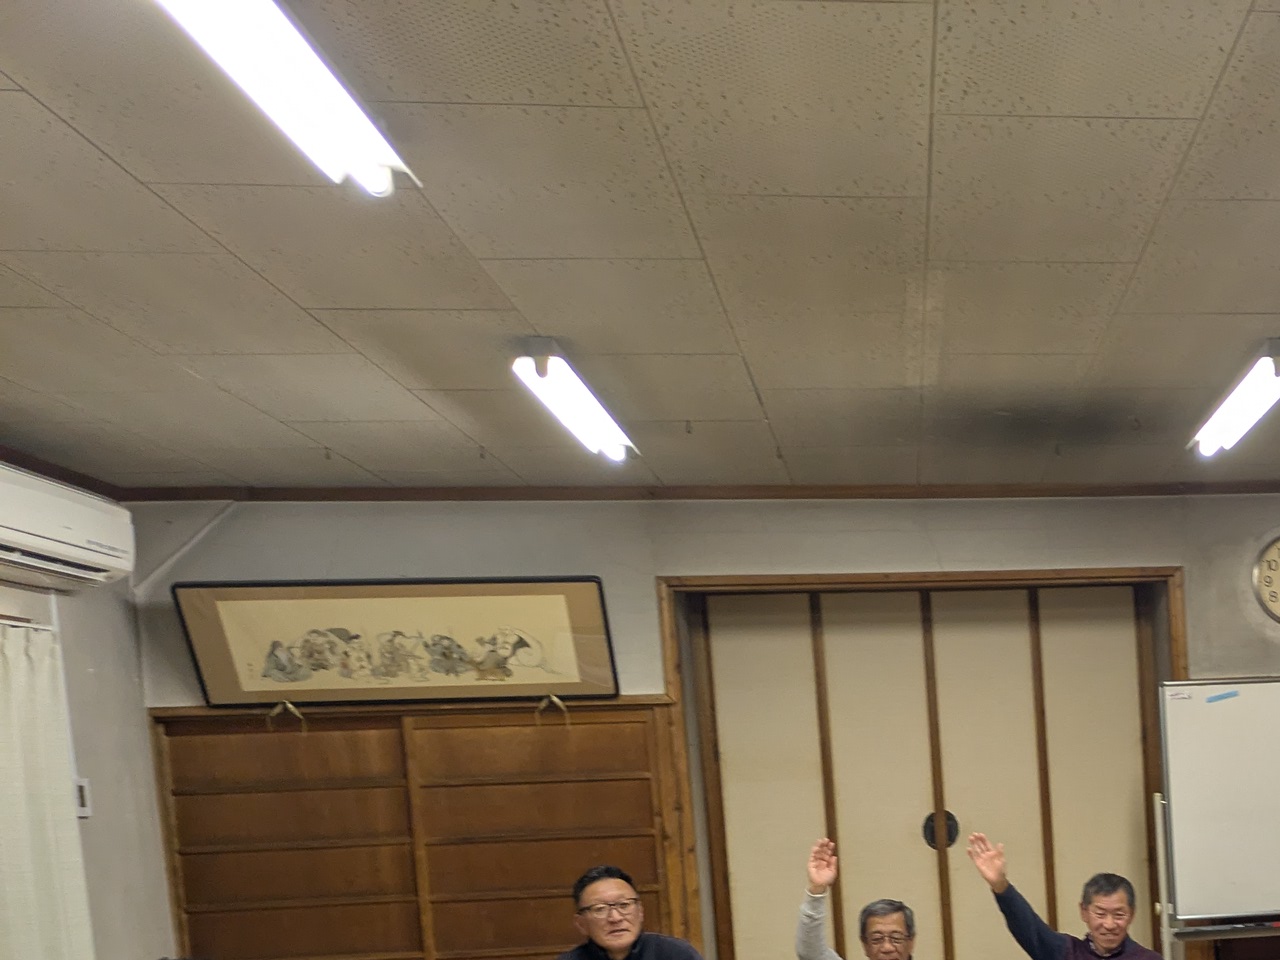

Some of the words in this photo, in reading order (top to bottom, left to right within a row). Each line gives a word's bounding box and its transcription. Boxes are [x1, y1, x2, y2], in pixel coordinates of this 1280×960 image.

[1265, 559, 1279, 572] 10
[1263, 575, 1273, 588] 9
[1268, 590, 1278, 603] 8
